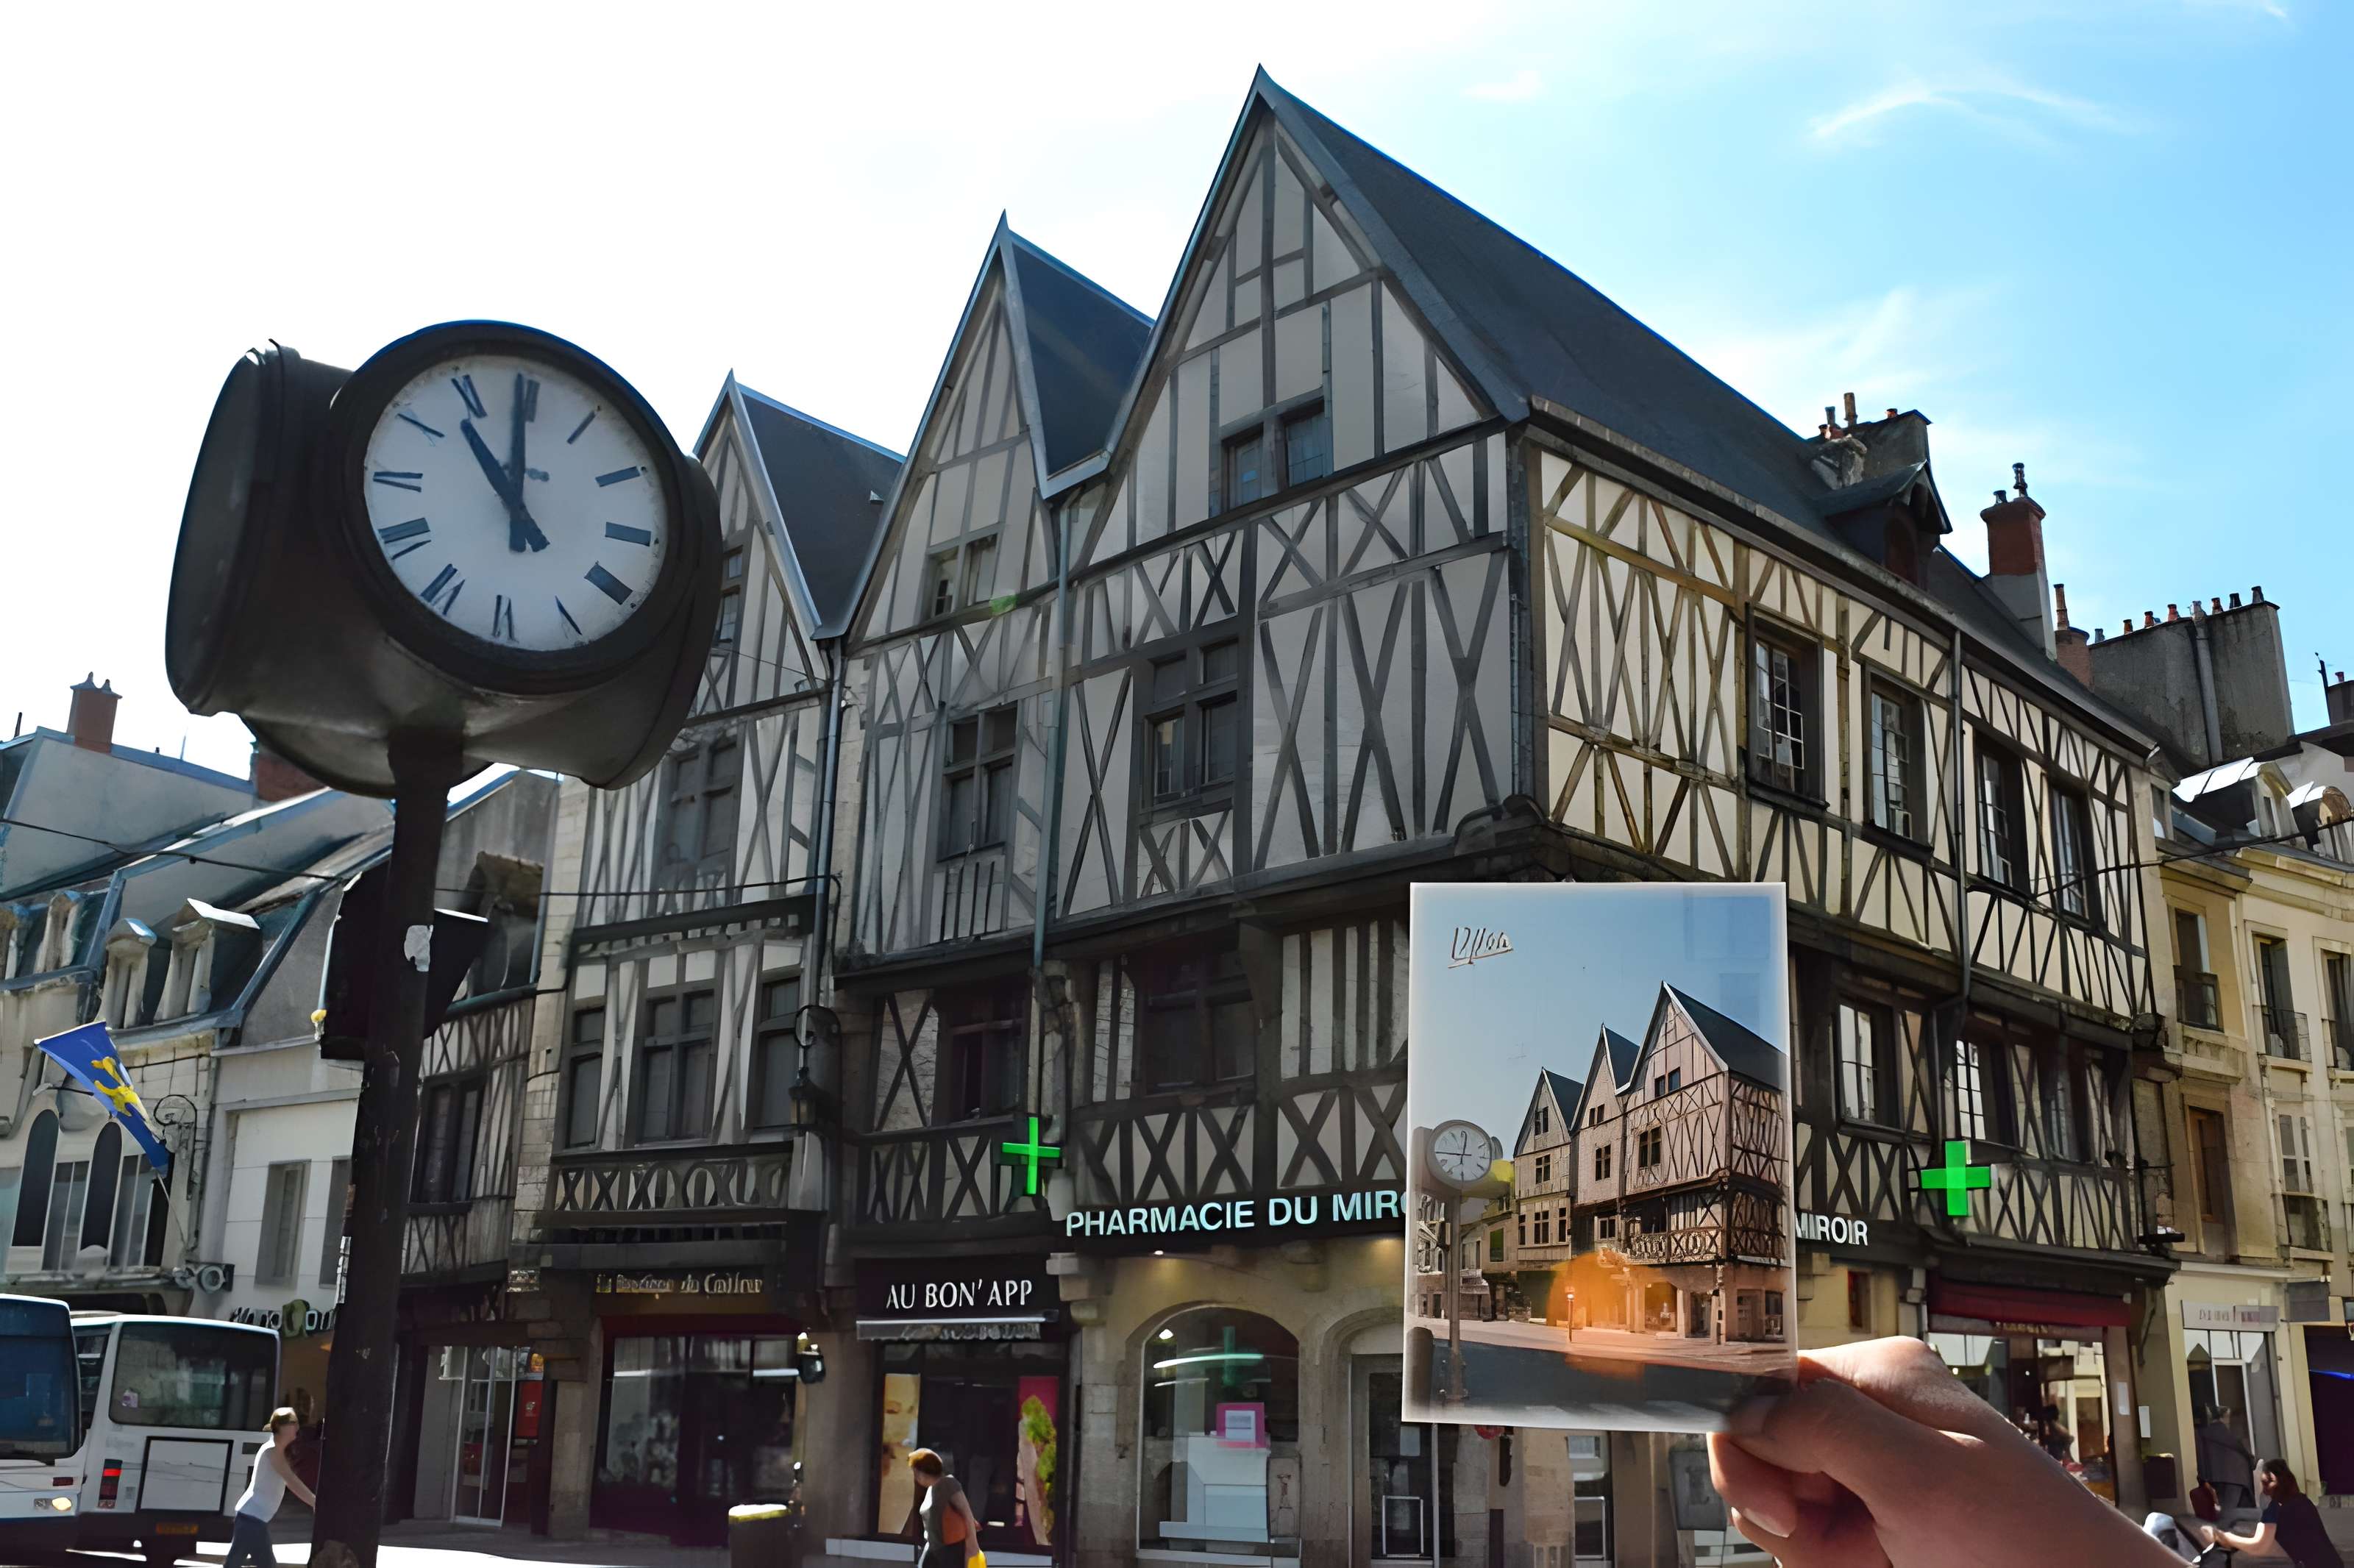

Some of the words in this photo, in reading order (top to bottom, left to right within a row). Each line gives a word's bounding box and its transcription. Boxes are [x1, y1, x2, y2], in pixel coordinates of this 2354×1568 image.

[1066, 1200, 1255, 1236] PHARMACIE
[1269, 1196, 1318, 1226] DU
[1332, 1190, 1406, 1221] MIR
[886, 1283, 915, 1309] AU
